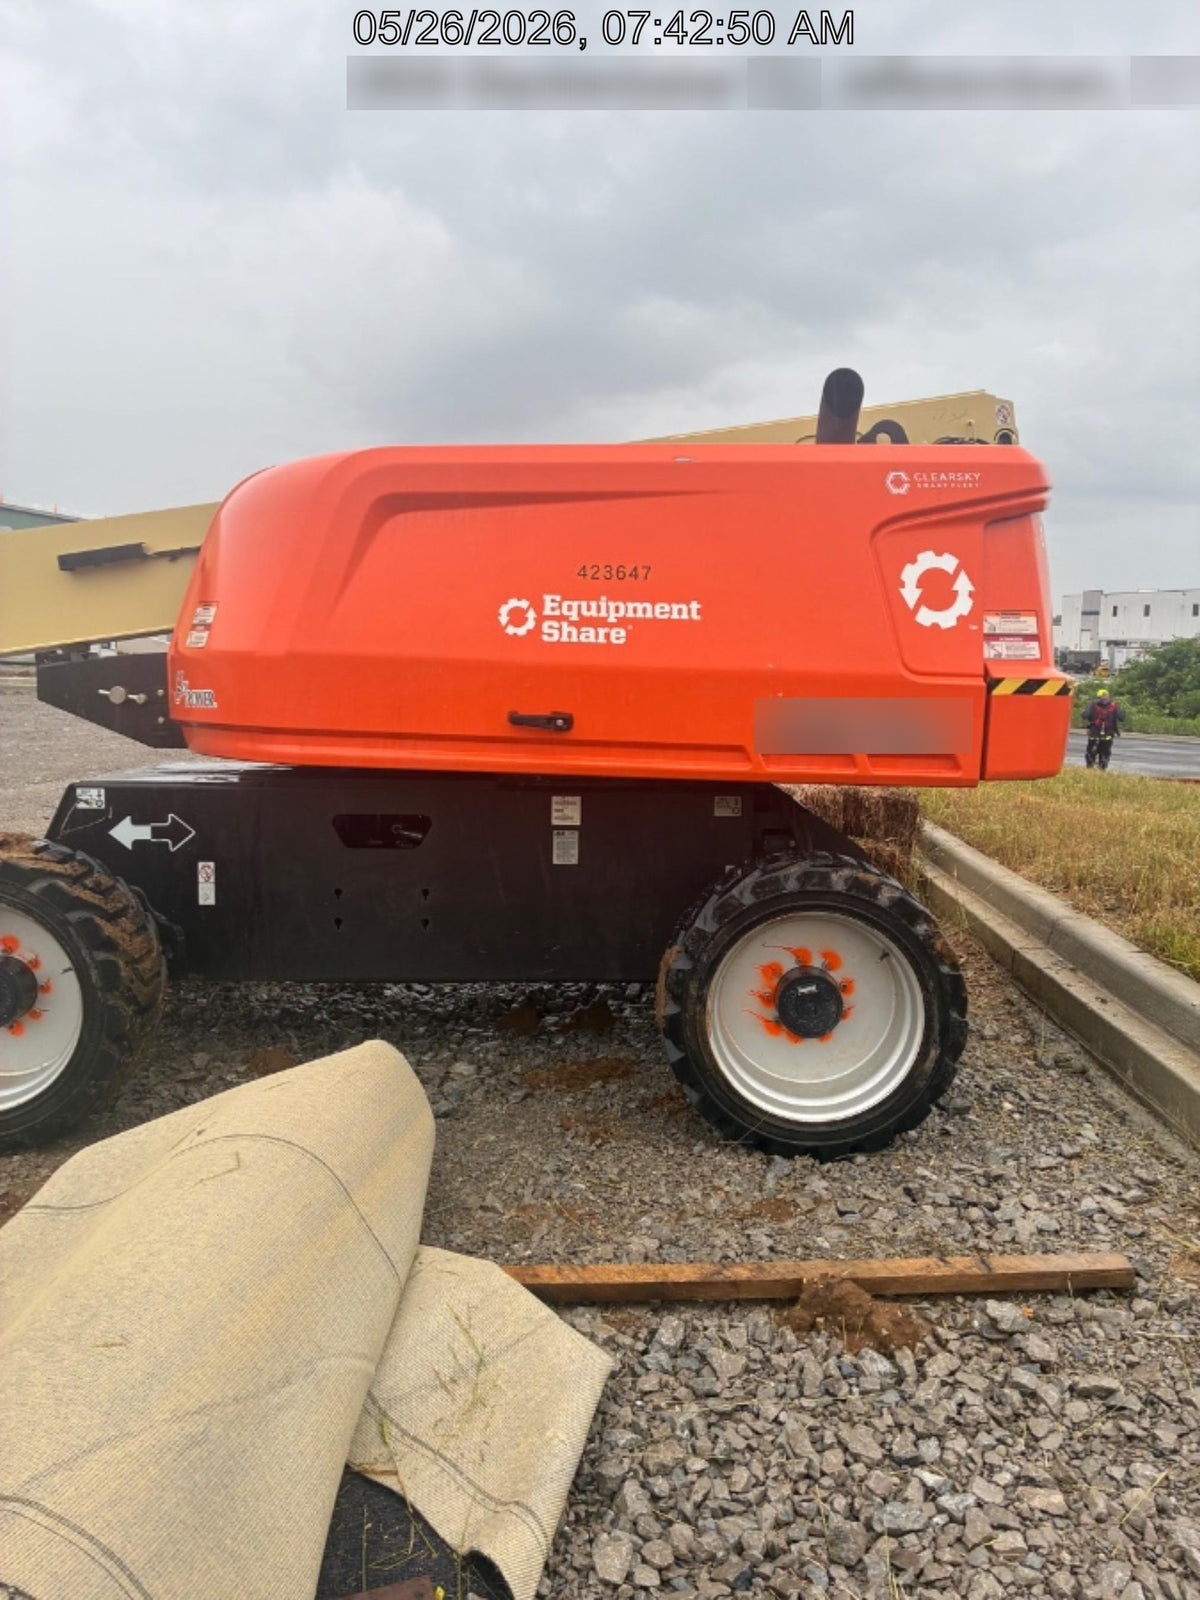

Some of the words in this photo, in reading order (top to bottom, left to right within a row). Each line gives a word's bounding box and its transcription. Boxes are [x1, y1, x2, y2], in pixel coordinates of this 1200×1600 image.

[913, 472, 981, 482] CLEARSKY
[577, 564, 652, 581] 423647
[541, 594, 702, 623] Equipment
[541, 620, 627, 644] Share
